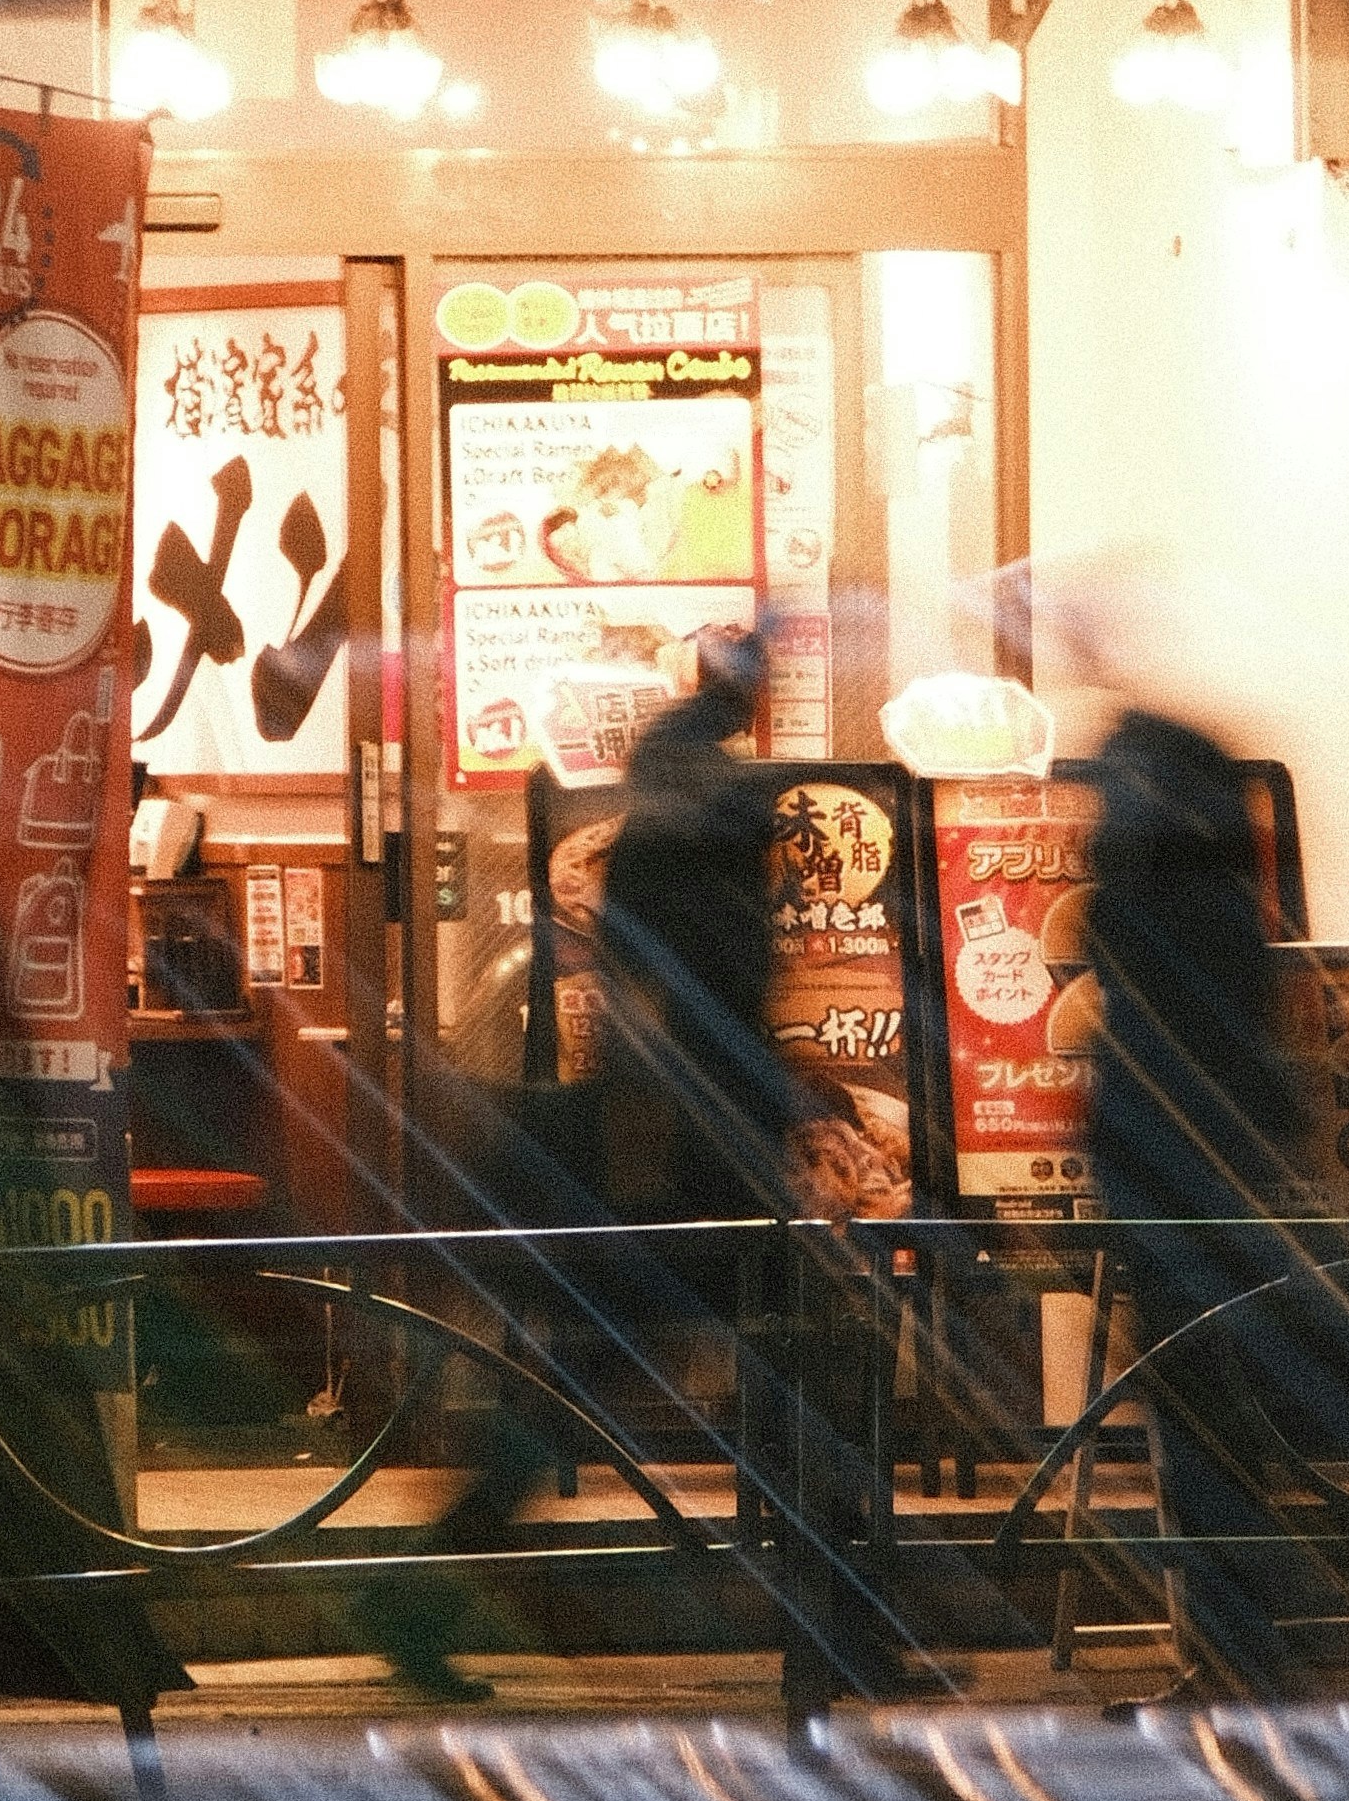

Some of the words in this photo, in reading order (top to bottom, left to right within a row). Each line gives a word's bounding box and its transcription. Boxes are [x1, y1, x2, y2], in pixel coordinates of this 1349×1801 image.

[576, 351, 665, 383] Ramen
[460, 413, 593, 434] ICHIKAKUYA
[461, 440, 525, 460] Special
[531, 440, 596, 458] Ramen
[131, 454, 348, 744] メン
[464, 599, 598, 620] ICHIKAKUYA
[465, 627, 529, 648] Special
[537, 627, 599, 645] Ramen
[831, 800, 884, 874] 背脂
[973, 950, 1031, 968] スタンプ
[981, 969, 1024, 985] カード
[975, 985, 1033, 1004] ポイント
[774, 1007, 902, 1058] 一杯!!
